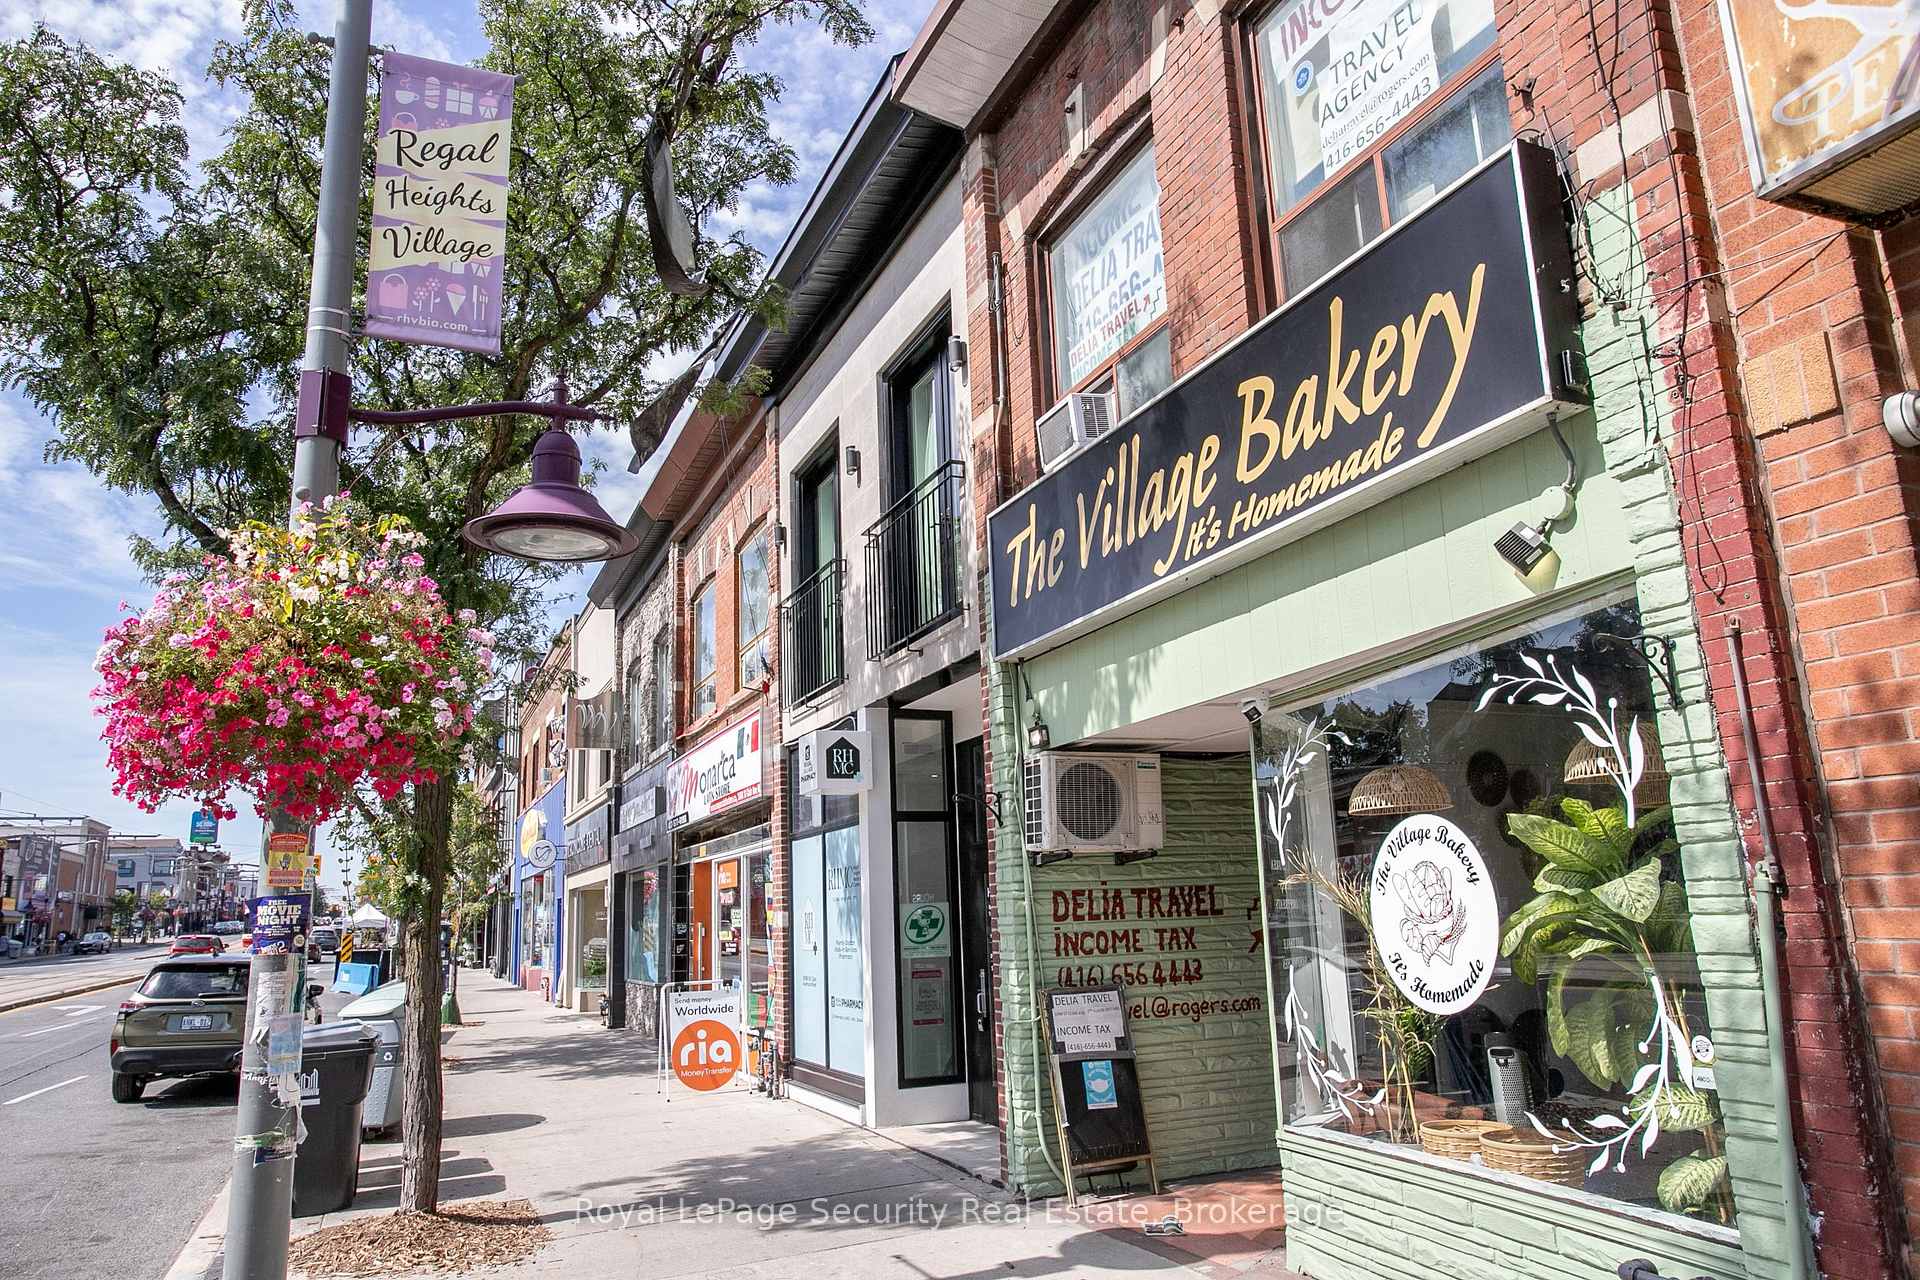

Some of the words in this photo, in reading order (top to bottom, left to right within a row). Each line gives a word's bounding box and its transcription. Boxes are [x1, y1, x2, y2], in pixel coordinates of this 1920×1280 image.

[1329, 2, 1422, 84] TRAVEL
[1320, 36, 1409, 129] AGENCY
[1325, 76, 1432, 169] 416-656-4443
[389, 129, 500, 171] Regal
[385, 175, 497, 215] Heights
[382, 226, 494, 264] Village
[1070, 334, 1099, 369] DELIA
[1100, 299, 1142, 343] TRAVEL
[1005, 503, 1066, 607] The
[1076, 432, 1221, 577] Village
[1236, 263, 1486, 485] Bakery
[1184, 505, 1222, 560] It's
[1228, 411, 1405, 538] Homemade
[832, 748, 854, 763] RH
[832, 761, 855, 775] MC
[1375, 860, 1392, 896] The
[1387, 825, 1432, 860] Village
[1434, 825, 1481, 886] Bakery
[256, 904, 302, 917] MOVIE
[256, 914, 300, 926] NIGHT
[1130, 885, 1224, 919] TRAVEL
[1154, 927, 1197, 951] TAX
[1058, 964, 1104, 988] (416)
[1111, 962, 1149, 987] 656
[1152, 959, 1204, 987] 4443
[1410, 958, 1485, 1004] Homemade
[674, 1003, 734, 1016] Worldwide
[1055, 995, 1079, 1006] DELIA
[1083, 993, 1113, 1003] TRAVEL
[680, 1029, 733, 1067] ria
[1057, 1024, 1092, 1036] INCOME
[1095, 1024, 1111, 1034] TAX
